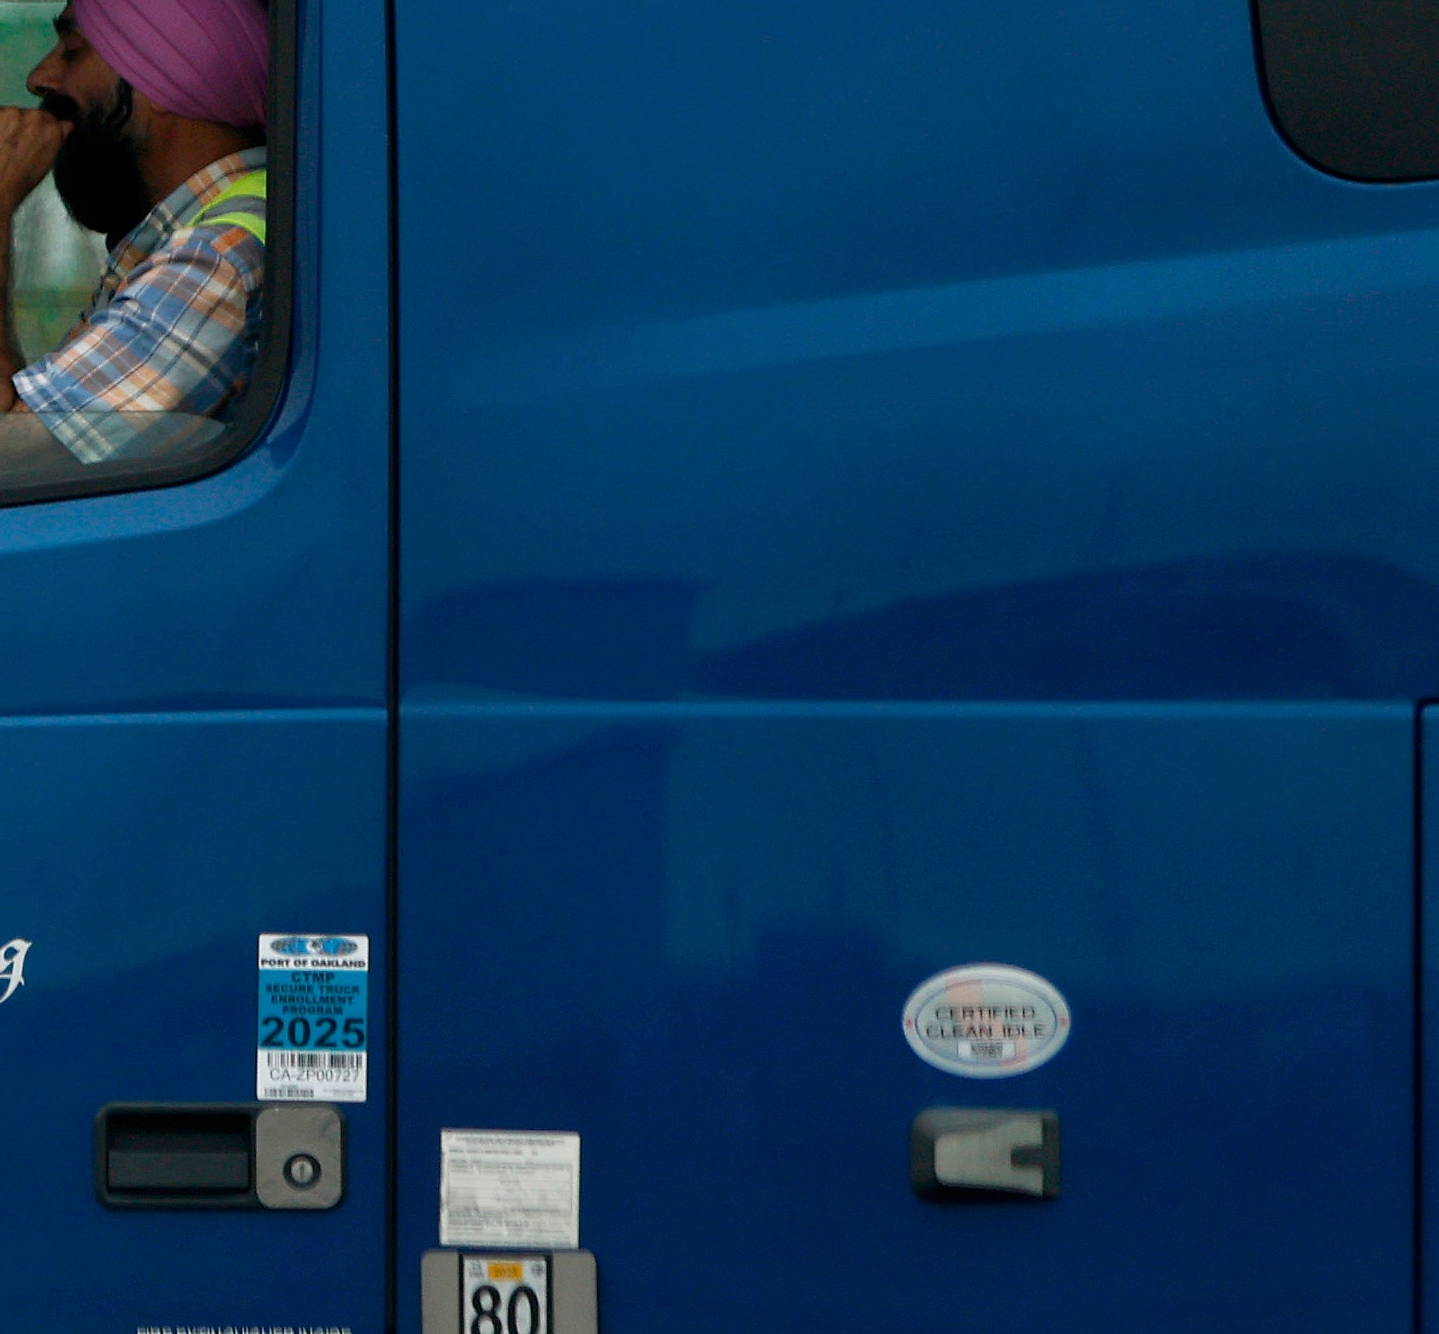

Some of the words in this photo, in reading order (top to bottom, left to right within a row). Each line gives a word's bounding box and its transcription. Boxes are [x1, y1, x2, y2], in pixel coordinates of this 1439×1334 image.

[261, 959, 290, 967] PORT
[294, 959, 308, 967] OF
[311, 959, 366, 968] OAKLAND
[291, 972, 335, 983] CTMP
[265, 984, 314, 994] SECURE
[319, 985, 360, 995] TRUCK
[271, 995, 354, 1005] ENROLLMENT
[282, 1005, 344, 1015] PROGRAM
[935, 1005, 1035, 1020] CERTIFIED
[260, 1017, 365, 1048] 2025
[926, 1025, 993, 1038] CLEAN
[1002, 1025, 1045, 1038] IDLE
